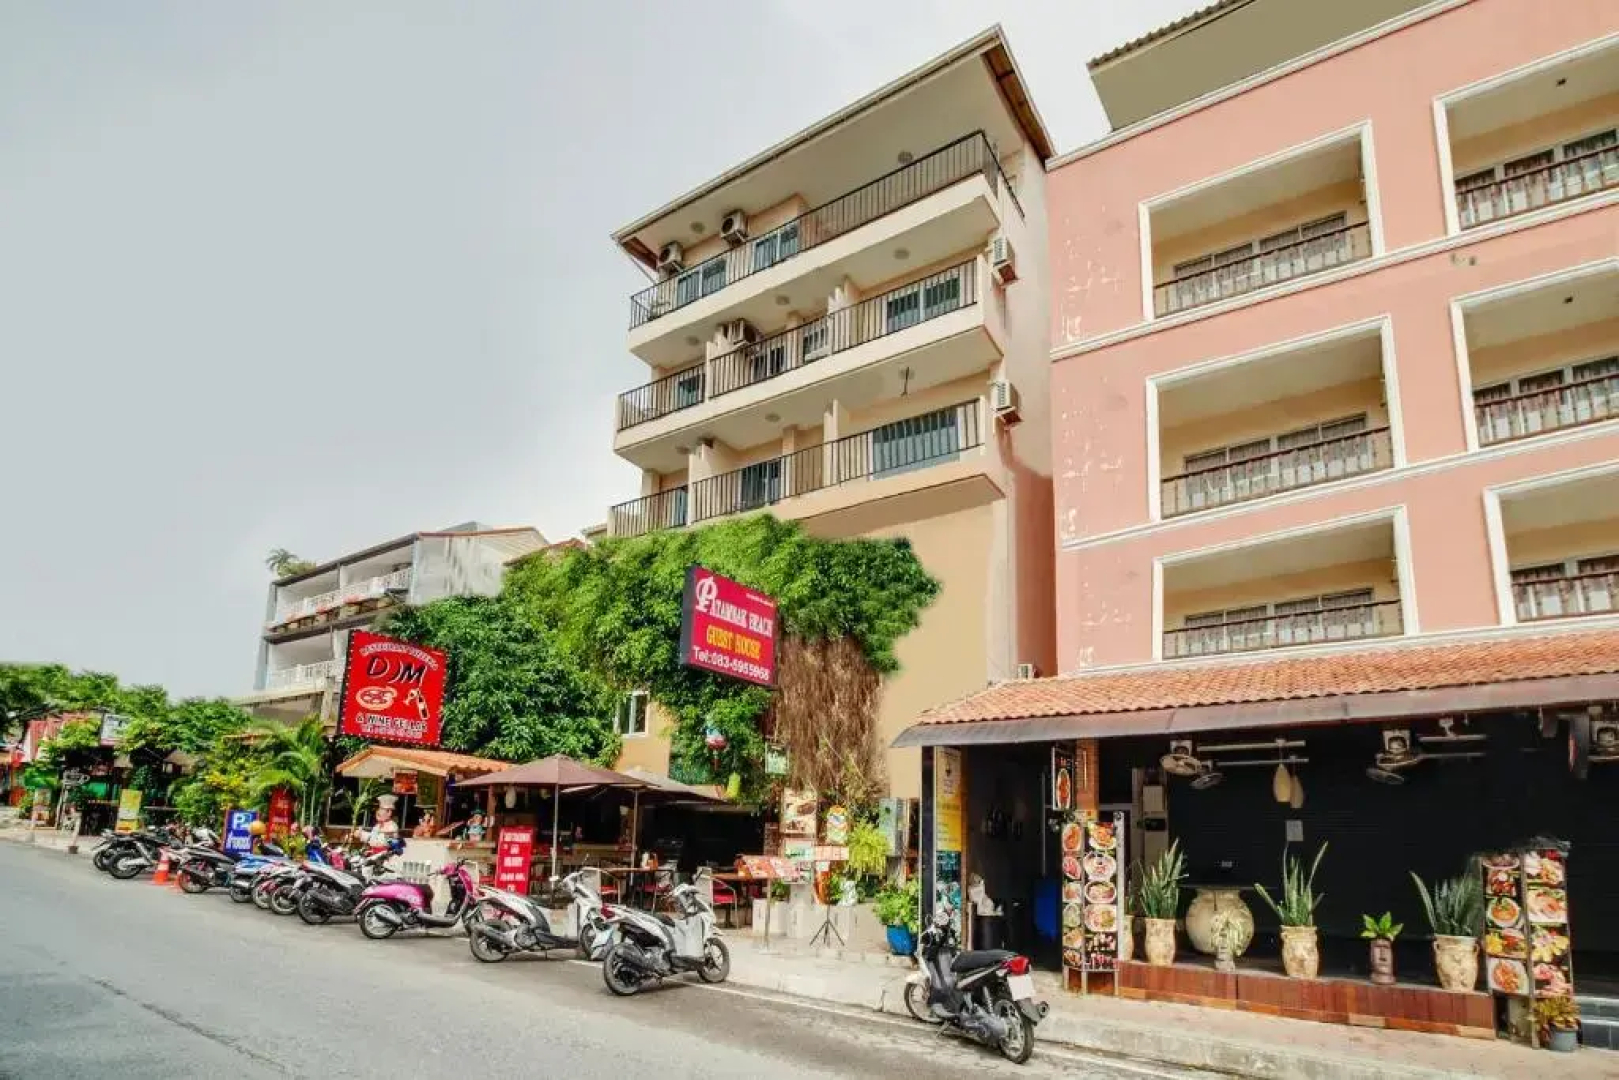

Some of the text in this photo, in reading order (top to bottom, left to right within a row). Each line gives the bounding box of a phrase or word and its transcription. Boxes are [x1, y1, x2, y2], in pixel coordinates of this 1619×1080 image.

[748, 612, 773, 638] BEACH
[706, 624, 761, 660] GUEST HOUSE
